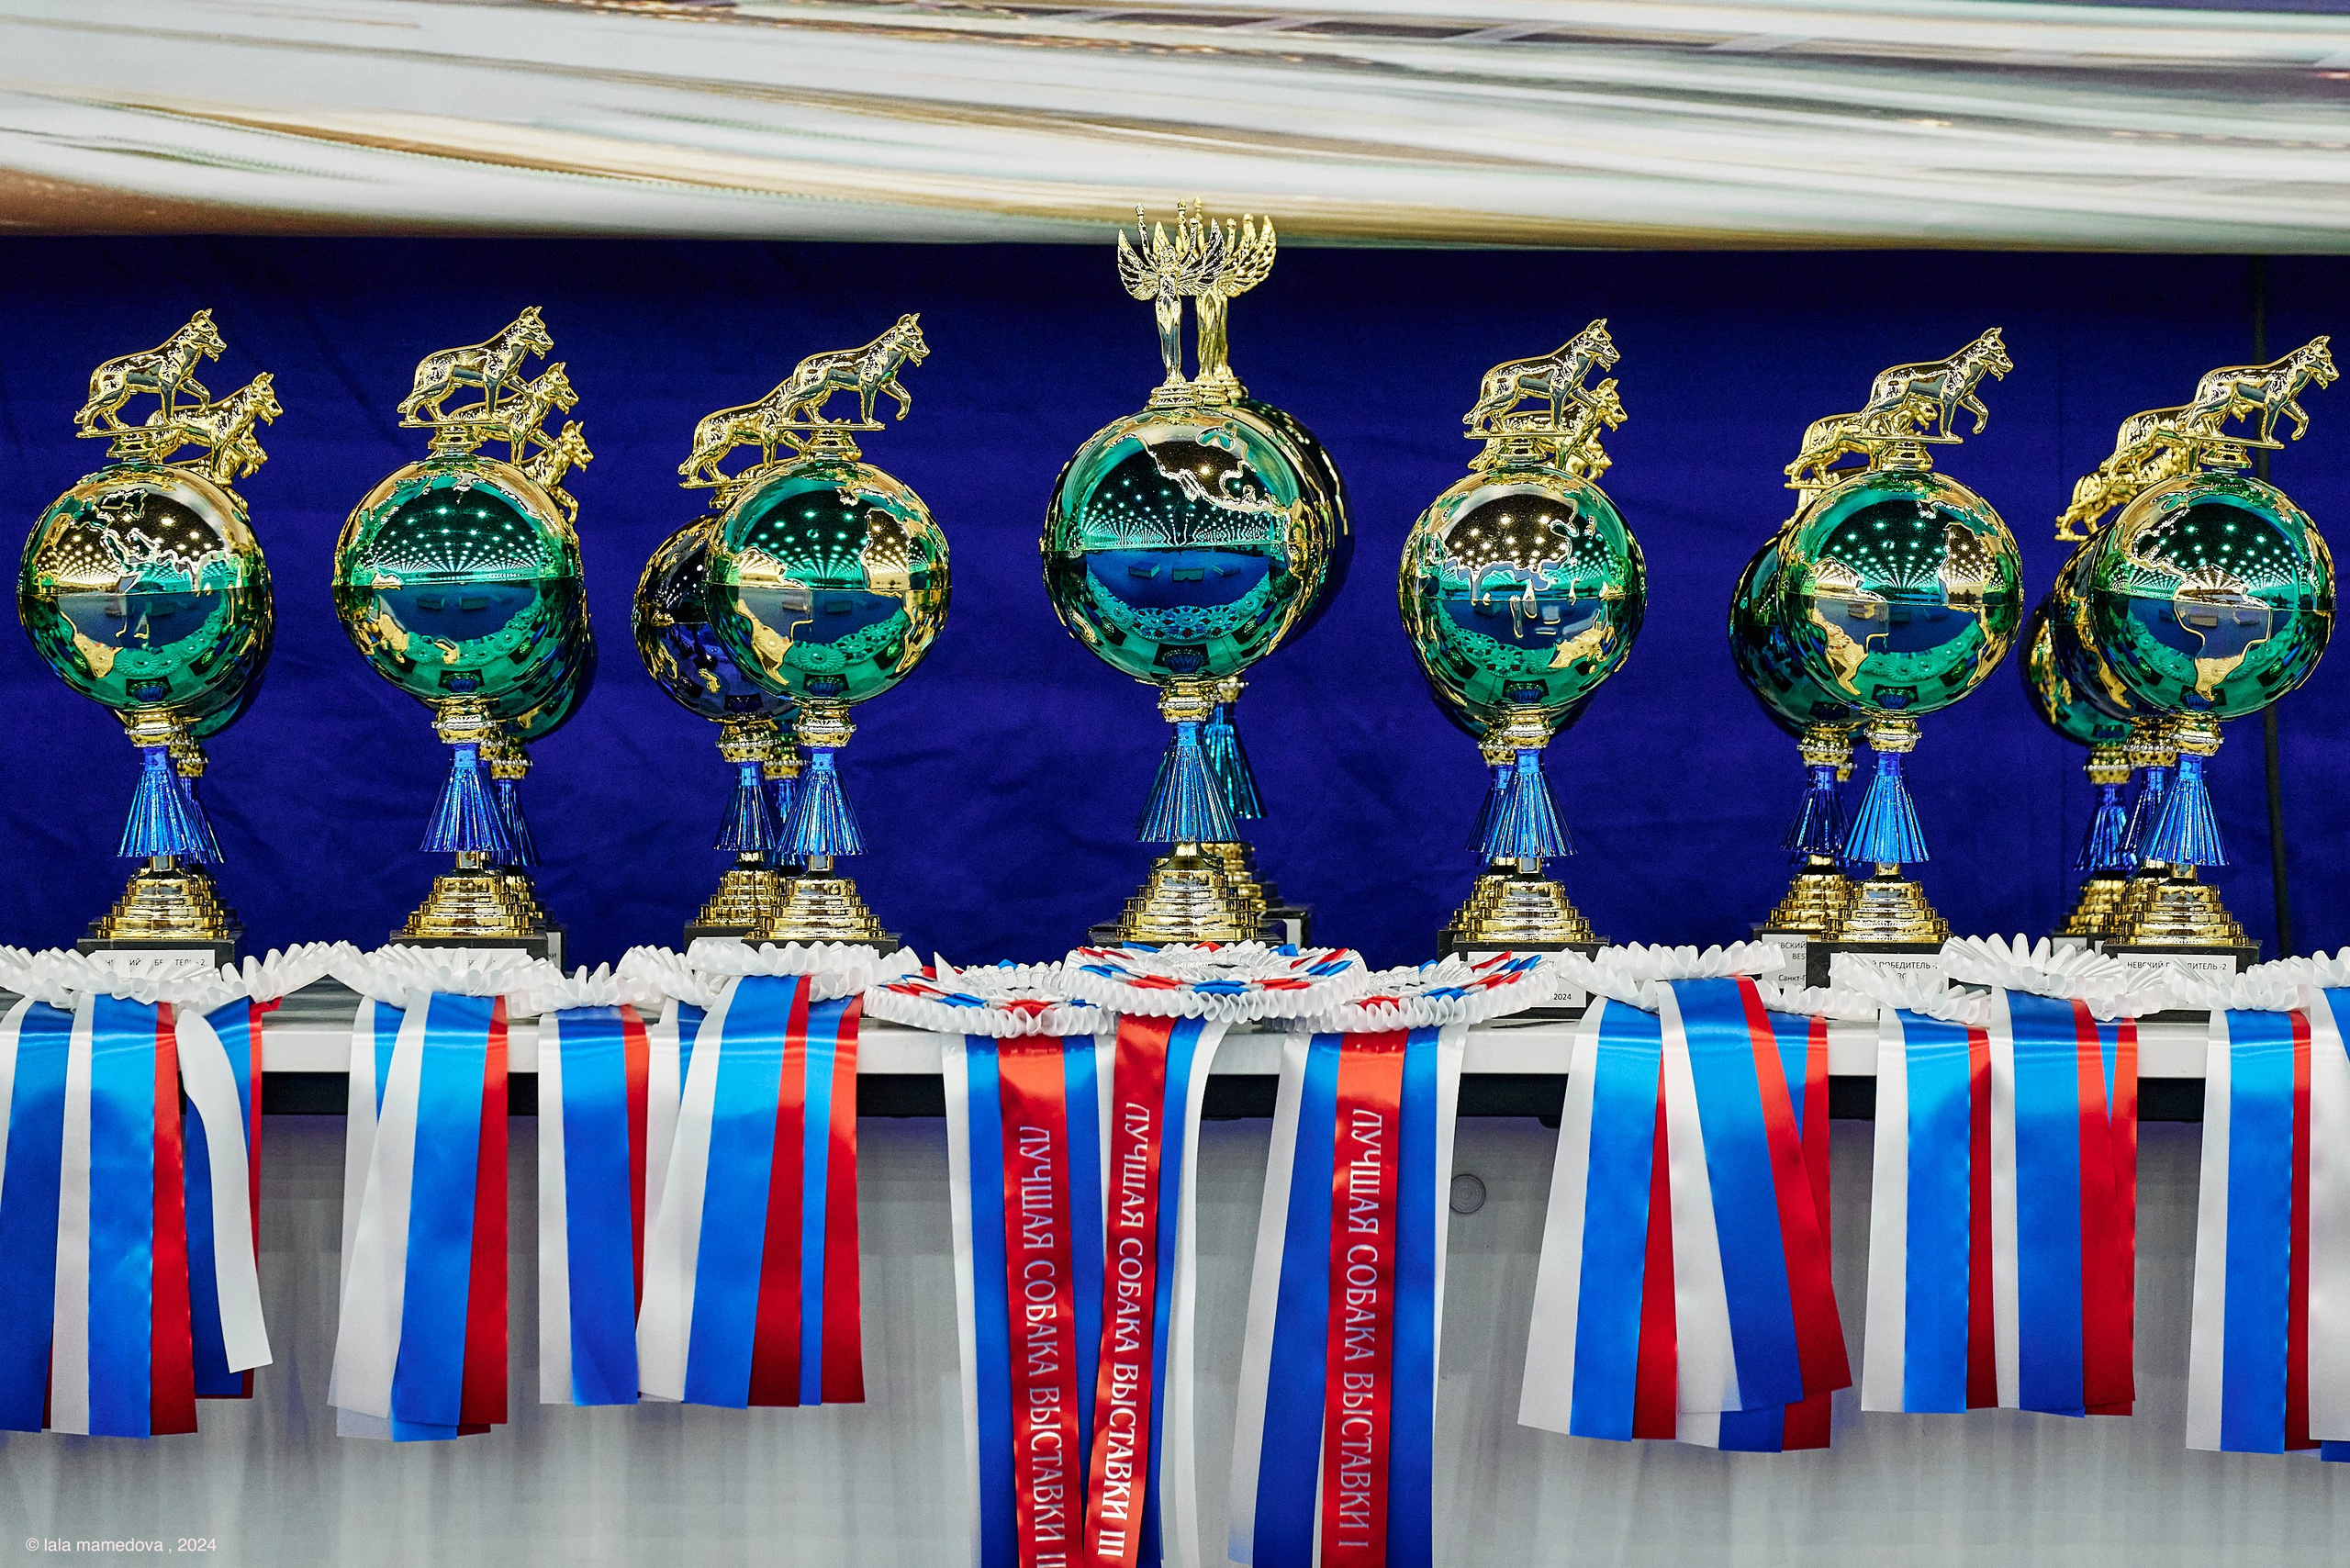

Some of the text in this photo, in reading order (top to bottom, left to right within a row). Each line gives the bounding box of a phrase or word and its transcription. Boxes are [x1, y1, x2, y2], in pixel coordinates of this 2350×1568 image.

[1019, 1126, 1054, 1249] ЛУЧШАЯ
[1120, 1102, 1150, 1228] ЛУЧШАЯ
[1348, 1108, 1382, 1235] ЛУЧШАЯ
[1024, 1260, 1058, 1377] СОБАКА
[1114, 1238, 1144, 1353] СОБАКА
[1344, 1244, 1379, 1361] СОБАКА
[1029, 1386, 1066, 1542] ВЫСТАВКИ
[1101, 1362, 1139, 1521] ВЫСТАВКИ
[1338, 1372, 1375, 1529] ВЫСТАВКИ
